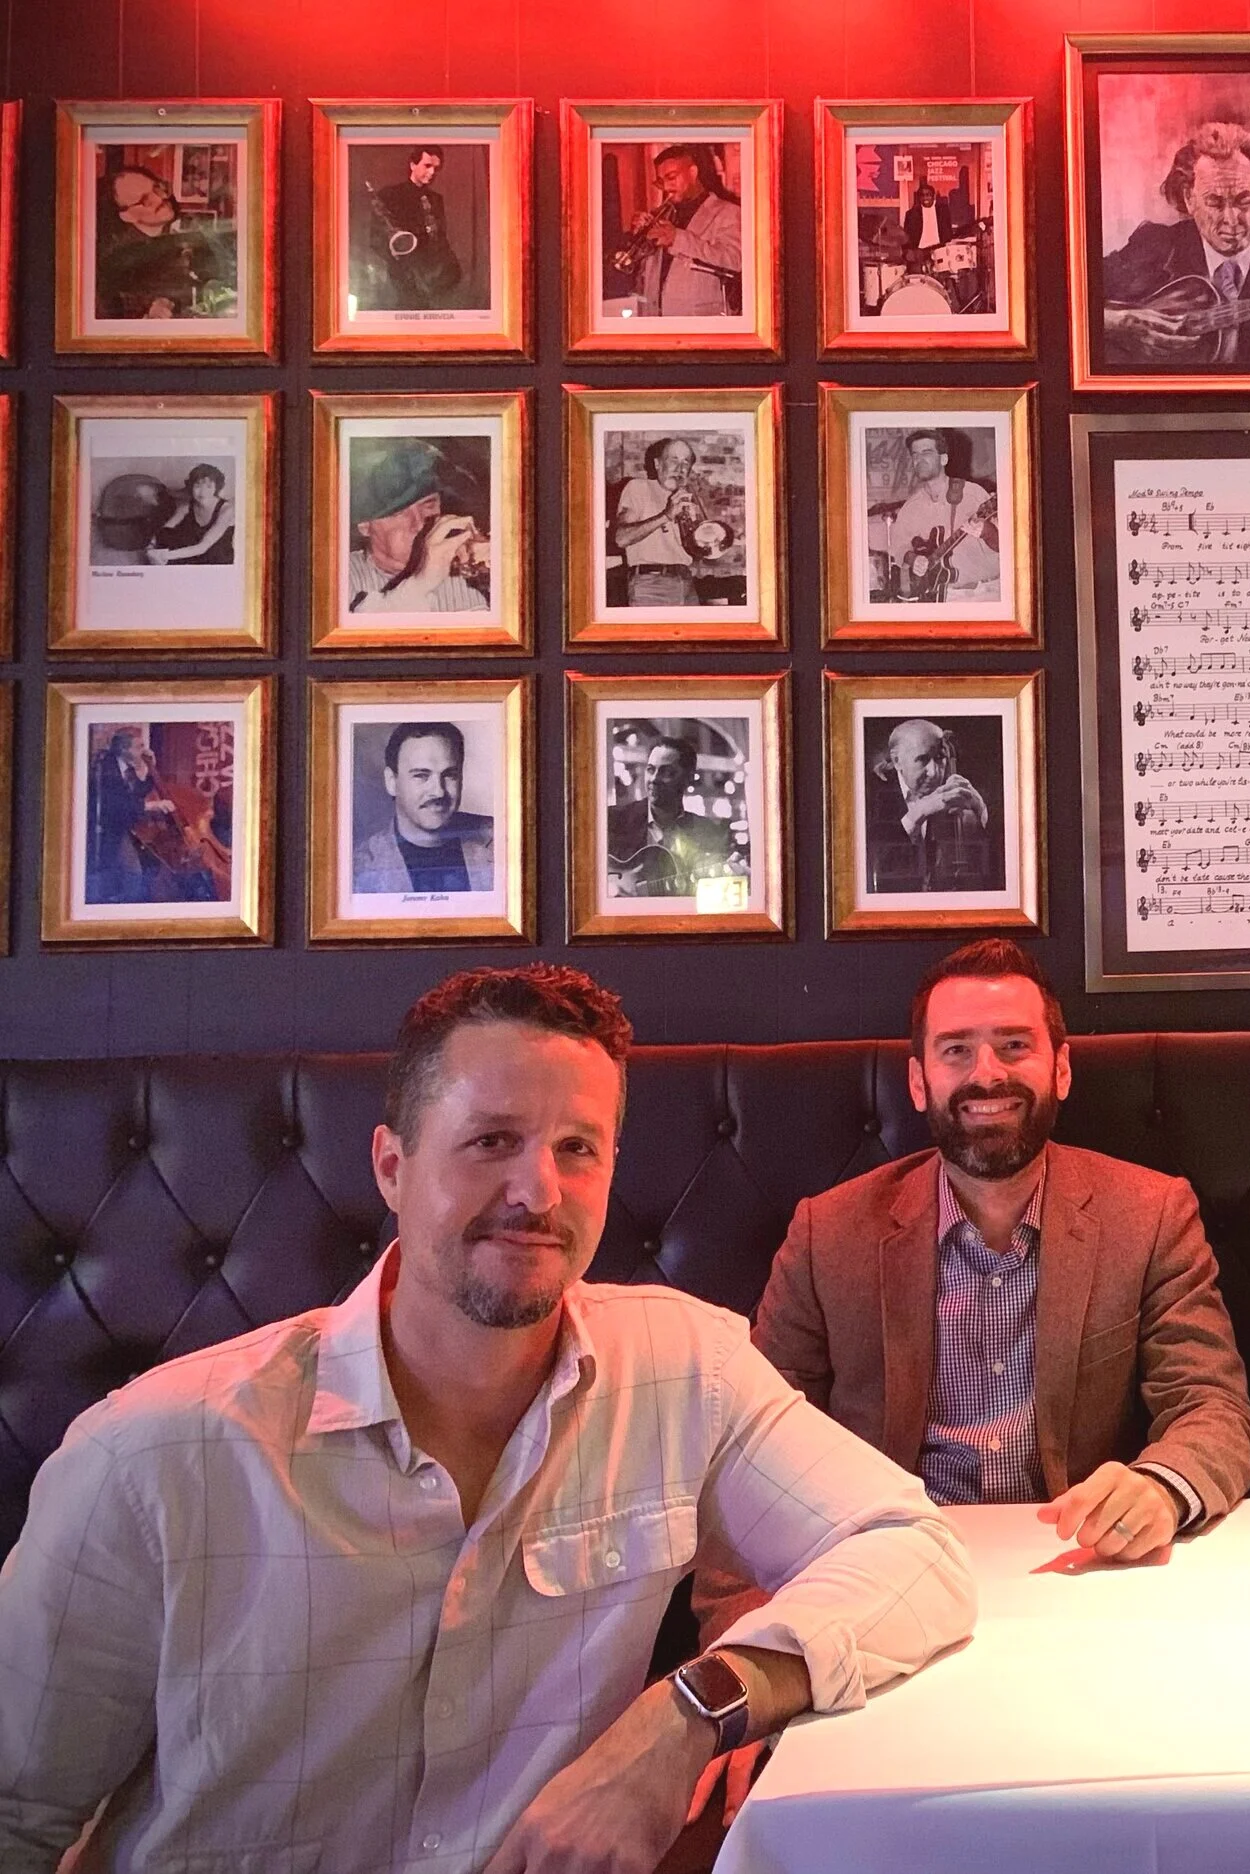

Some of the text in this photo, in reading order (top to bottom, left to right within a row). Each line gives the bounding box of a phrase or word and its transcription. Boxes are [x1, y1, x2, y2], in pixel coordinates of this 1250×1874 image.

[1150, 681, 1170, 689] ain't
[1164, 730, 1183, 738] What
[1185, 729, 1204, 738] could
